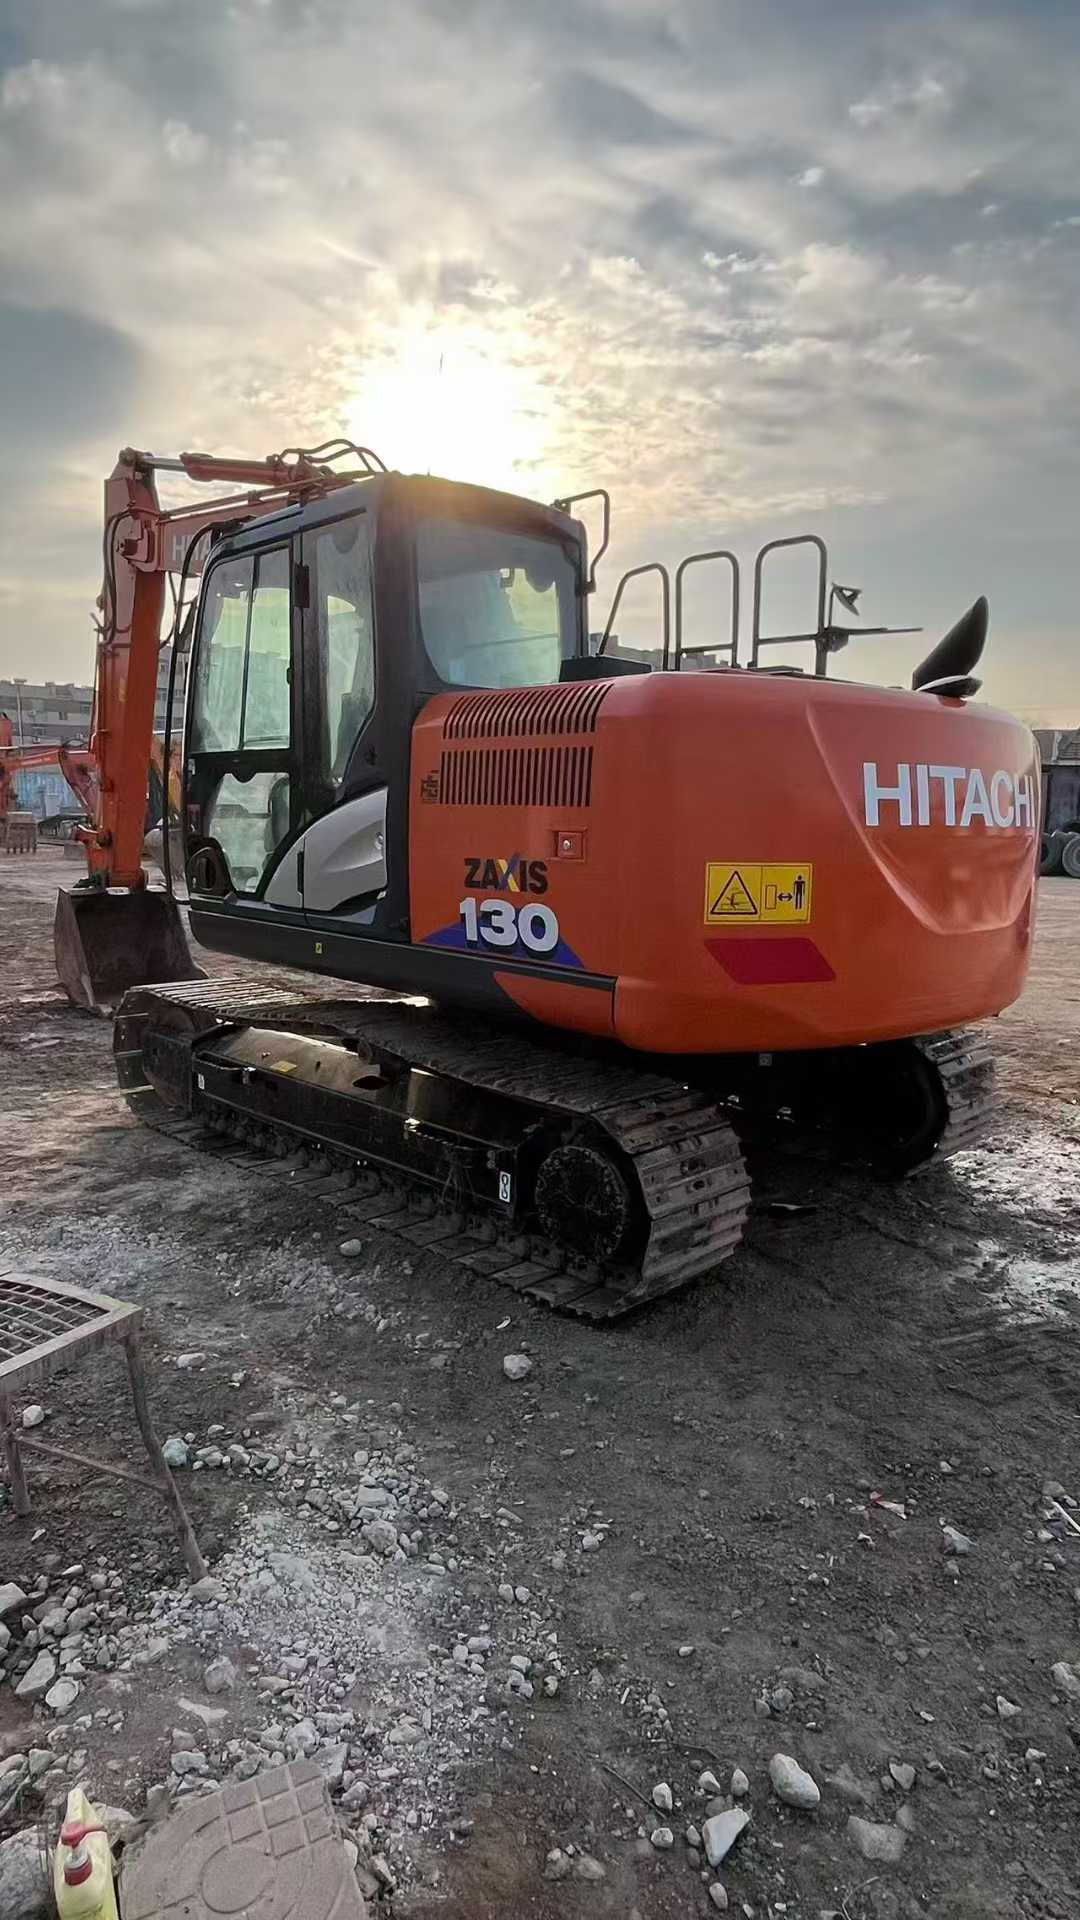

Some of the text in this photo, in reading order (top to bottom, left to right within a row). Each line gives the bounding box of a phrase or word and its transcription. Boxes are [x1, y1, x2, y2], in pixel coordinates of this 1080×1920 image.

[863, 762, 1035, 828] HITACHI
[464, 853, 548, 894] ZAXIS
[459, 897, 559, 953] 130
